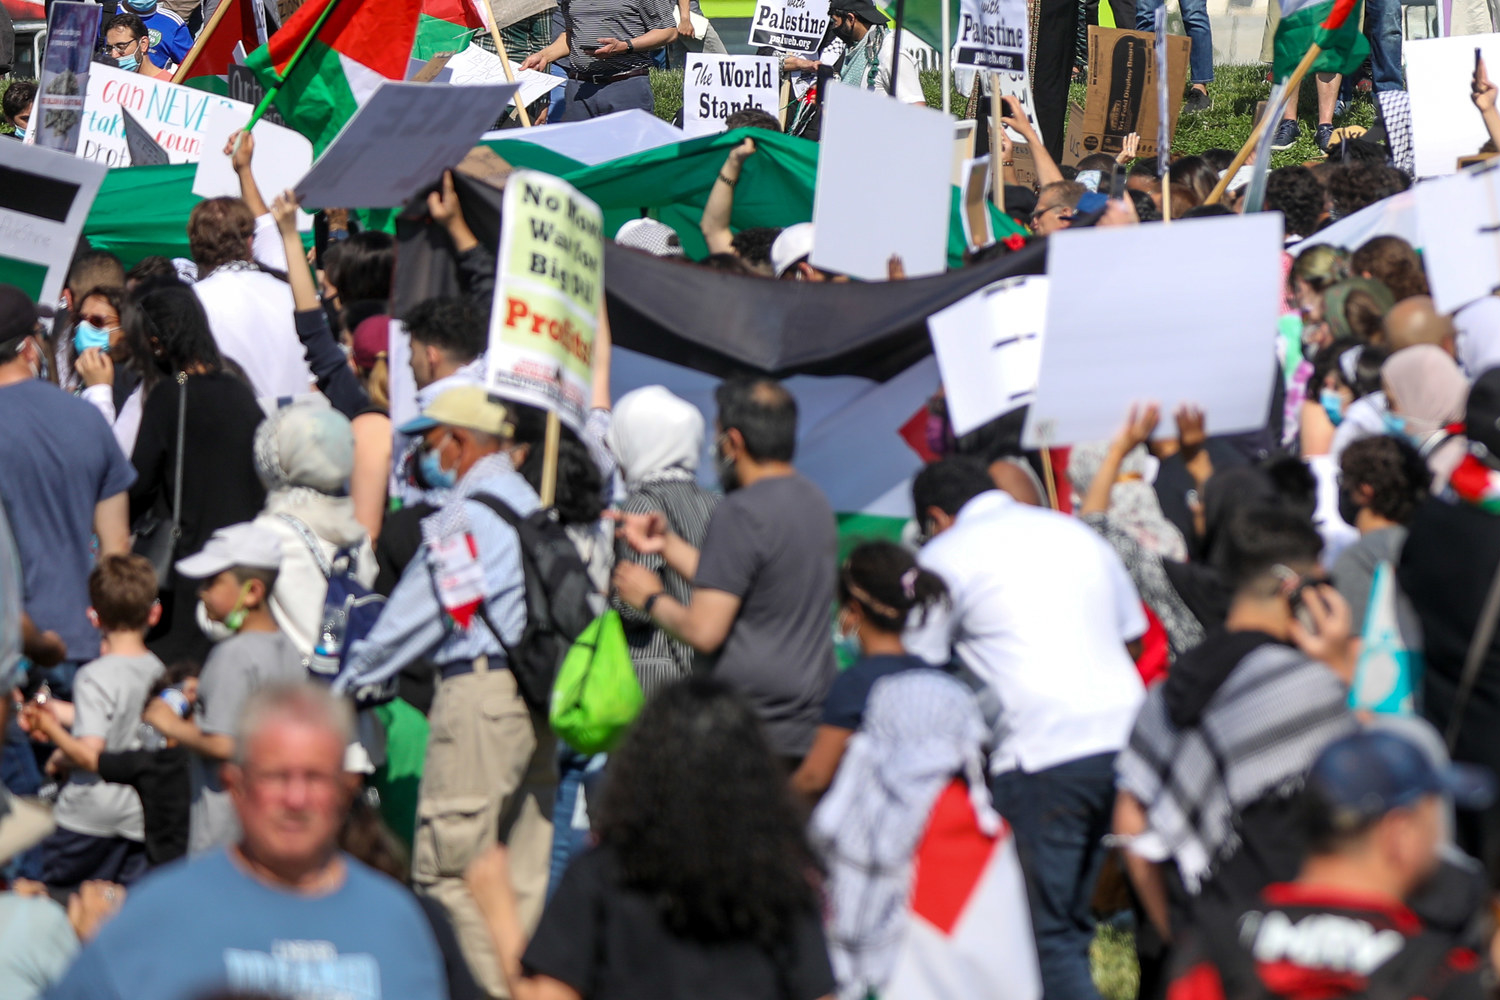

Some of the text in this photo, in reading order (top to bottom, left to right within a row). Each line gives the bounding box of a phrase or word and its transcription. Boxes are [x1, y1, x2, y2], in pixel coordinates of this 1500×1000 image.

[756, 4, 827, 36] Palestine
[962, 13, 1023, 49] Palestine
[1126, 41, 1135, 68] Board
[692, 60, 773, 89] The World
[1123, 68, 1134, 98] Display
[102, 79, 145, 111] can
[145, 83, 233, 133] NEVE
[523, 182, 560, 213] No
